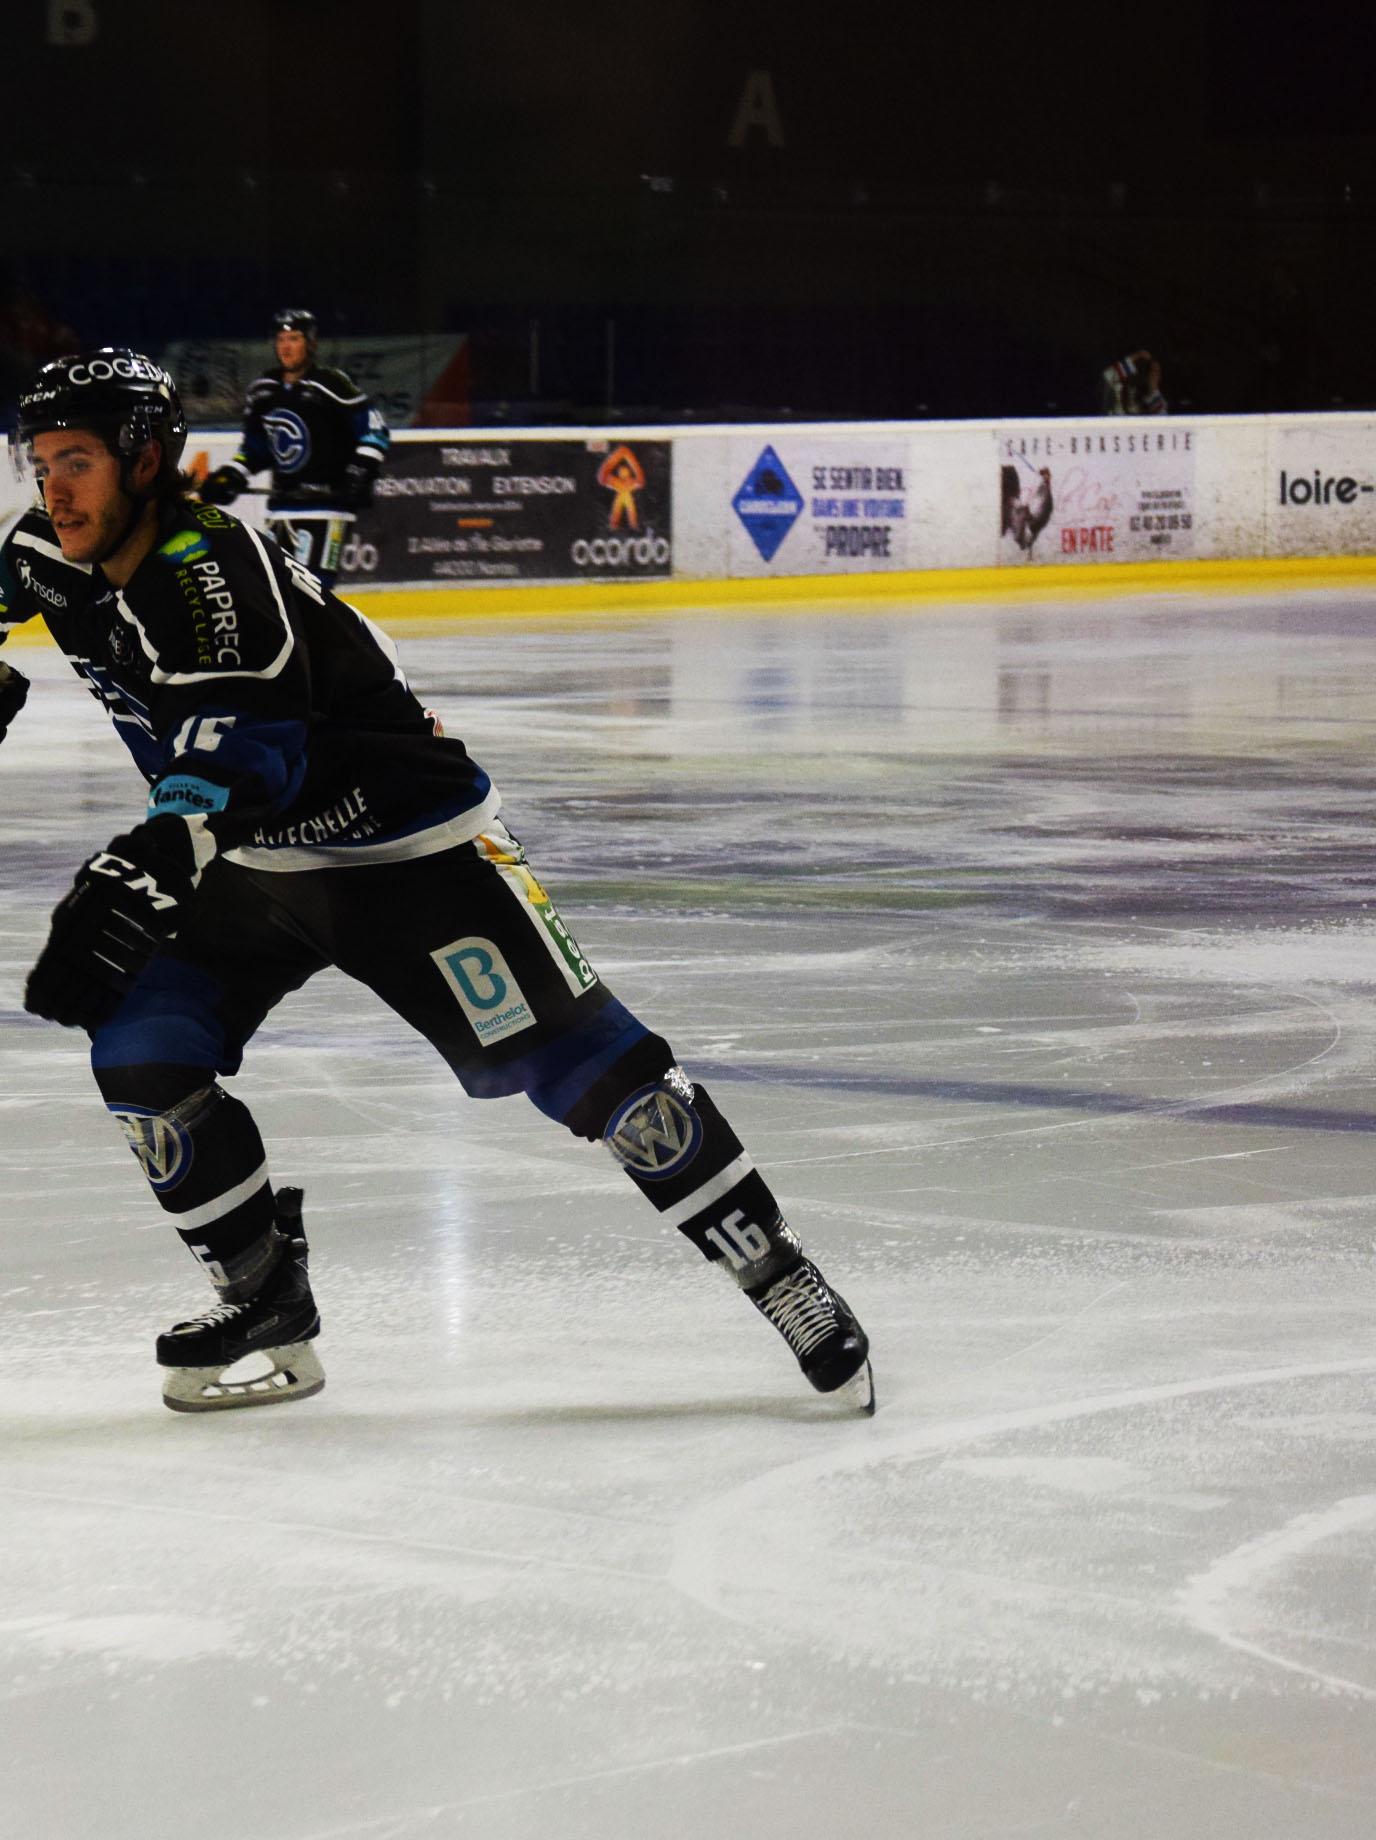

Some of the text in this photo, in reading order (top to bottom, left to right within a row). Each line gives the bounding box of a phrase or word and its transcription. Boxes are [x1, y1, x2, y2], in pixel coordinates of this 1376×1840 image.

[726, 69, 786, 147] A
[492, 475, 575, 496] EXTENSION
[175, 568, 212, 665] RECYCLAGE
[192, 561, 242, 666] PAPREC
[474, 1003, 527, 1032] Berthelot
[704, 1208, 771, 1271] 16
